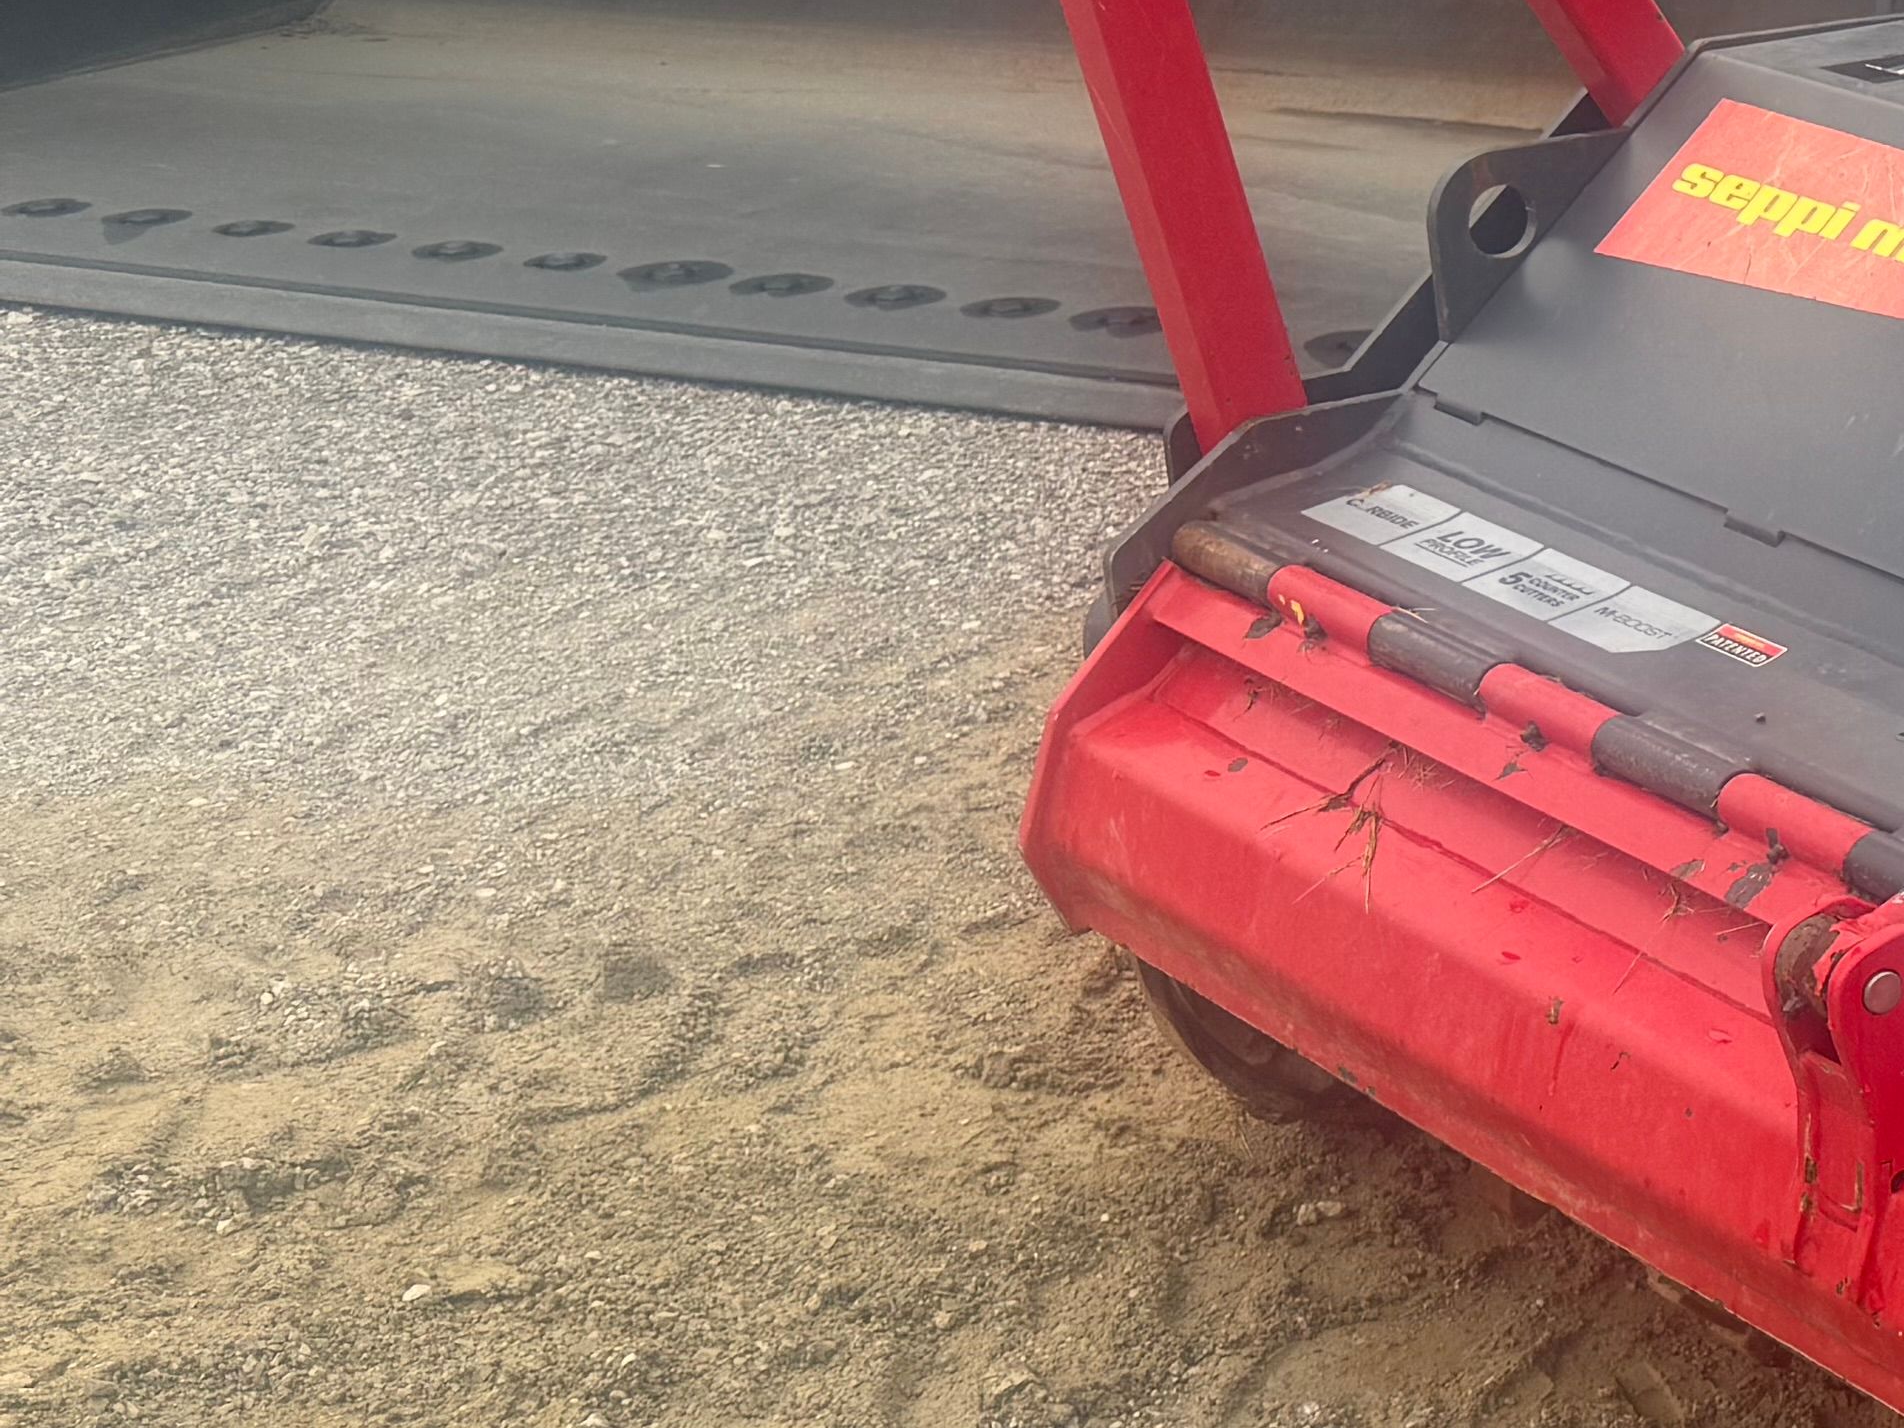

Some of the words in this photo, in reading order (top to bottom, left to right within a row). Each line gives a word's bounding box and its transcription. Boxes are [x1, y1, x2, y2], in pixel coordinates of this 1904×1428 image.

[1671, 163, 1862, 241] seppi
[1419, 538, 1486, 567] PROFILE
[1436, 530, 1512, 561] LOW
[1499, 572, 1533, 586] 5
[1528, 576, 1581, 602] COUNTER
[1512, 583, 1565, 608] CUTTERS
[1703, 633, 1767, 663] PATENTED
